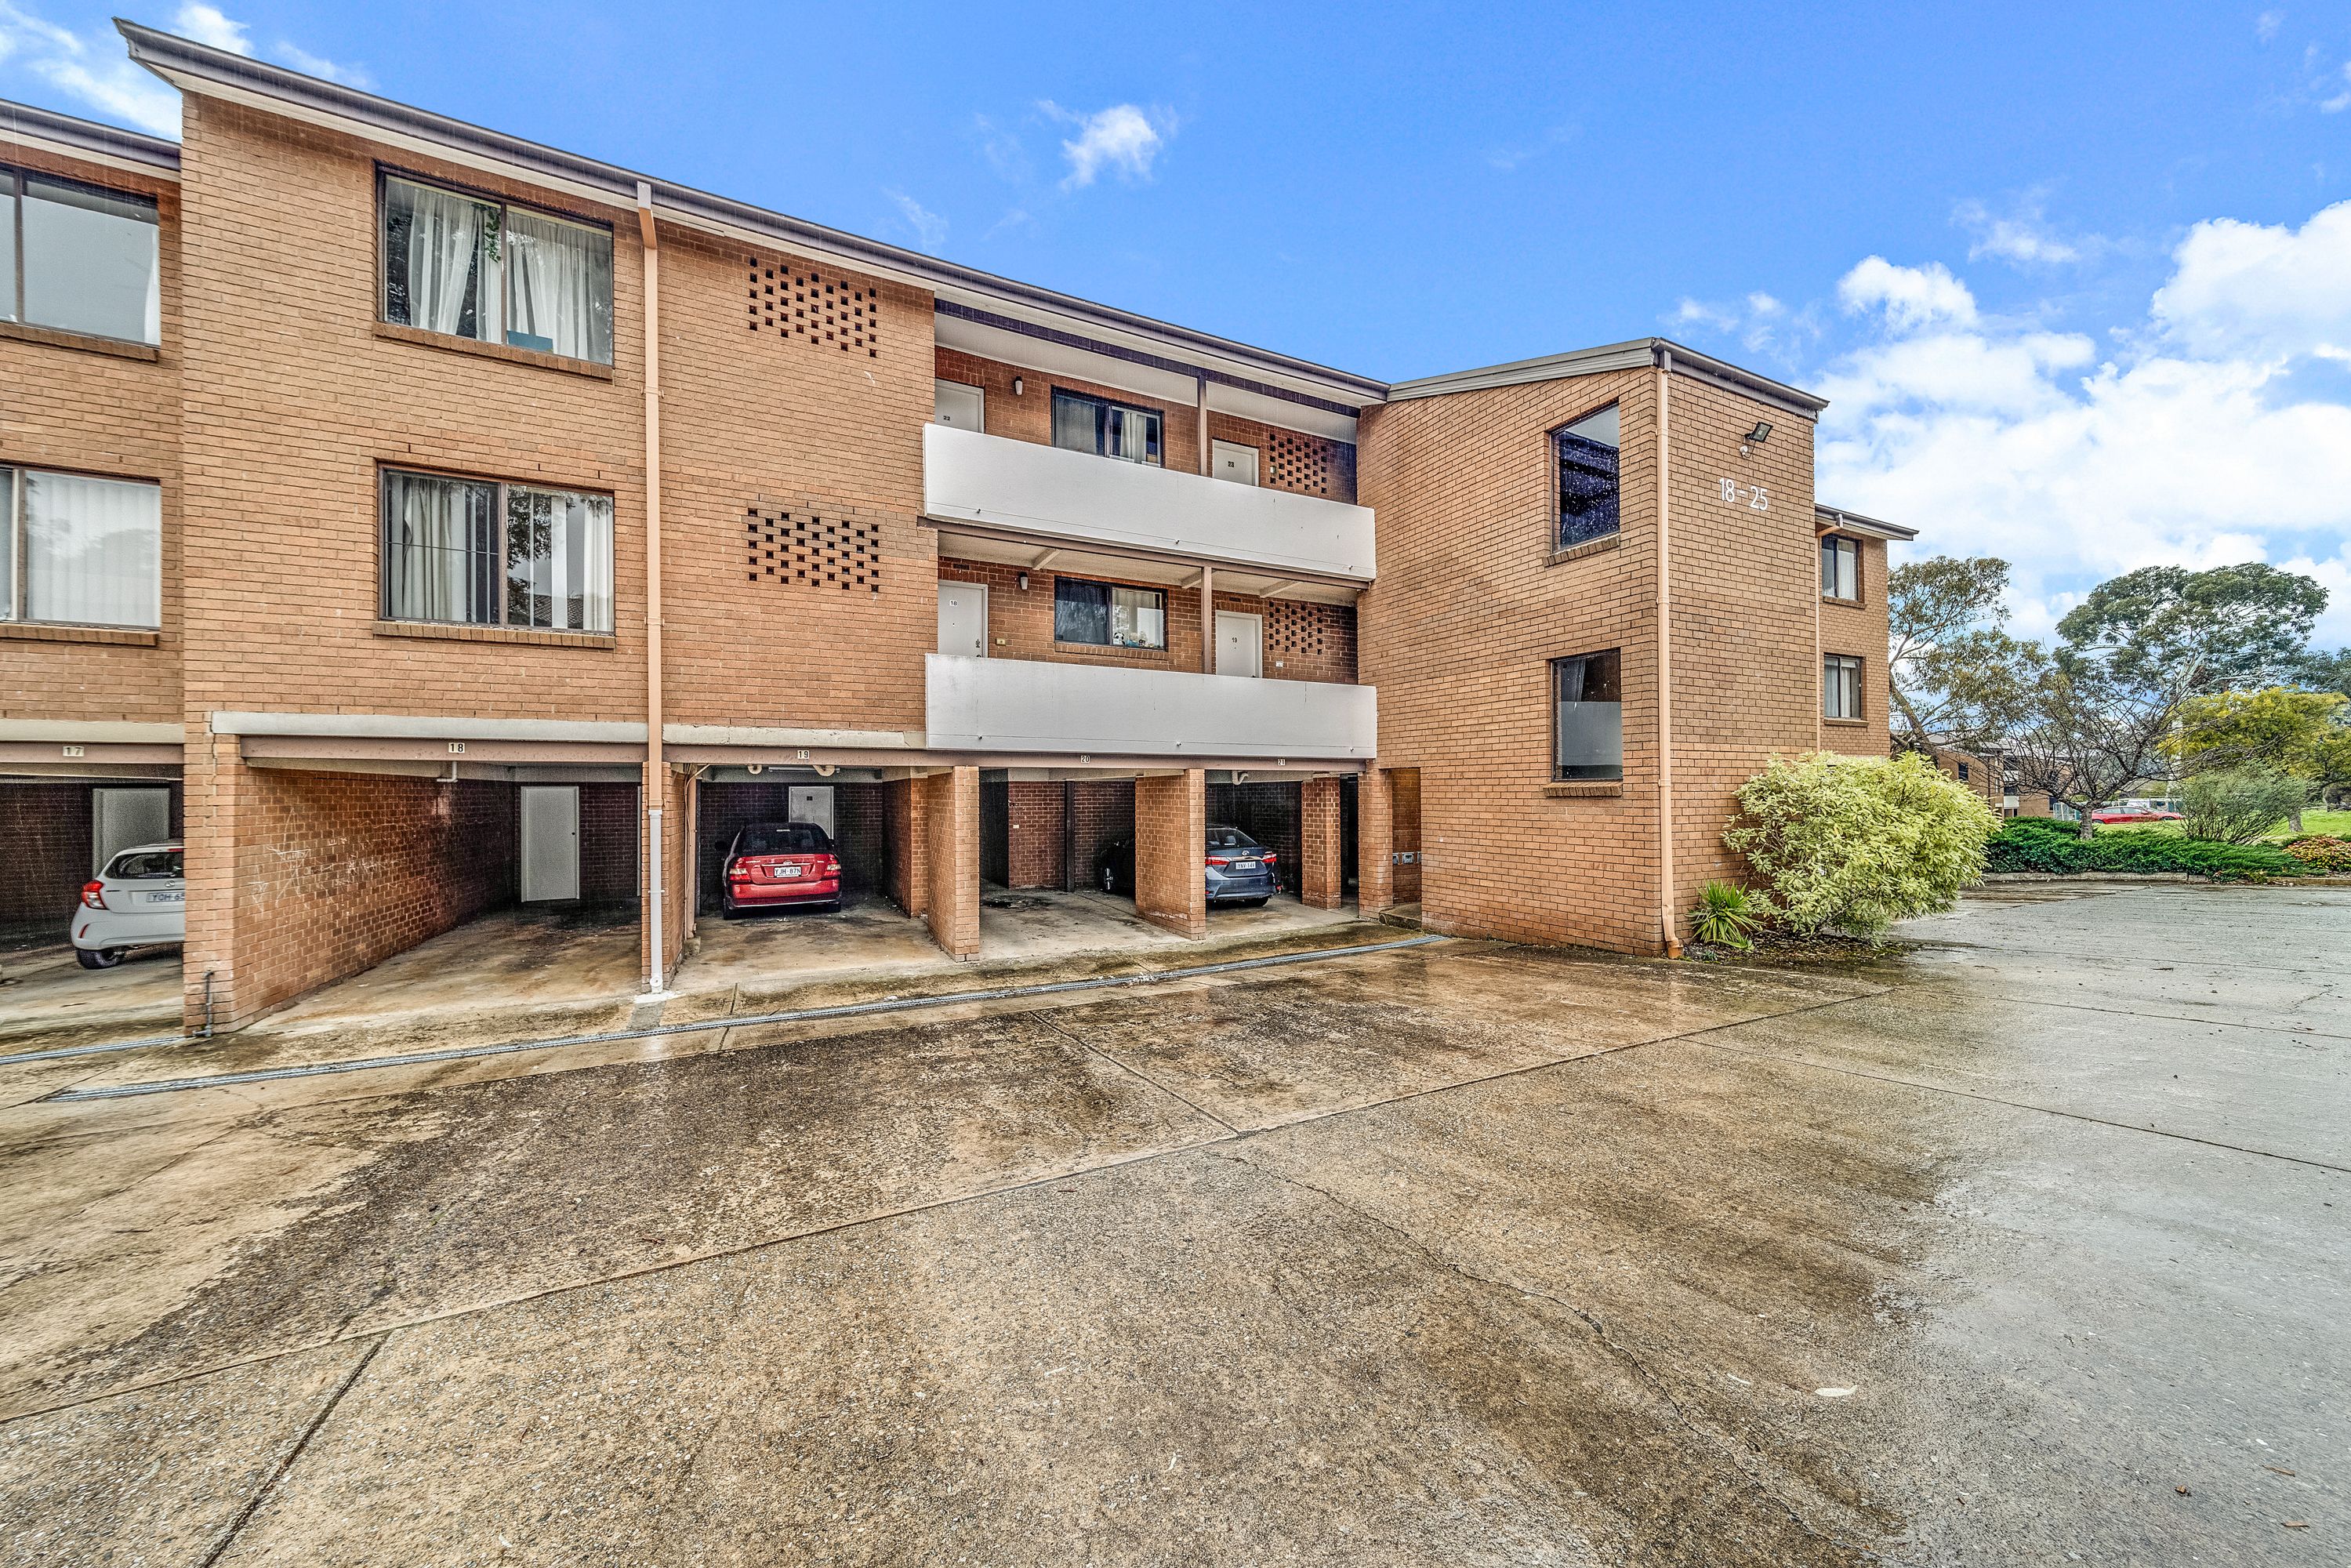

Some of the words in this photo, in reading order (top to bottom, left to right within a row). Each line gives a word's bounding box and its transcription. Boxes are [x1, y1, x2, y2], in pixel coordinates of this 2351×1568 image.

[66, 746, 83, 756] 17
[450, 743, 463, 753] 18
[798, 750, 809, 759] 19
